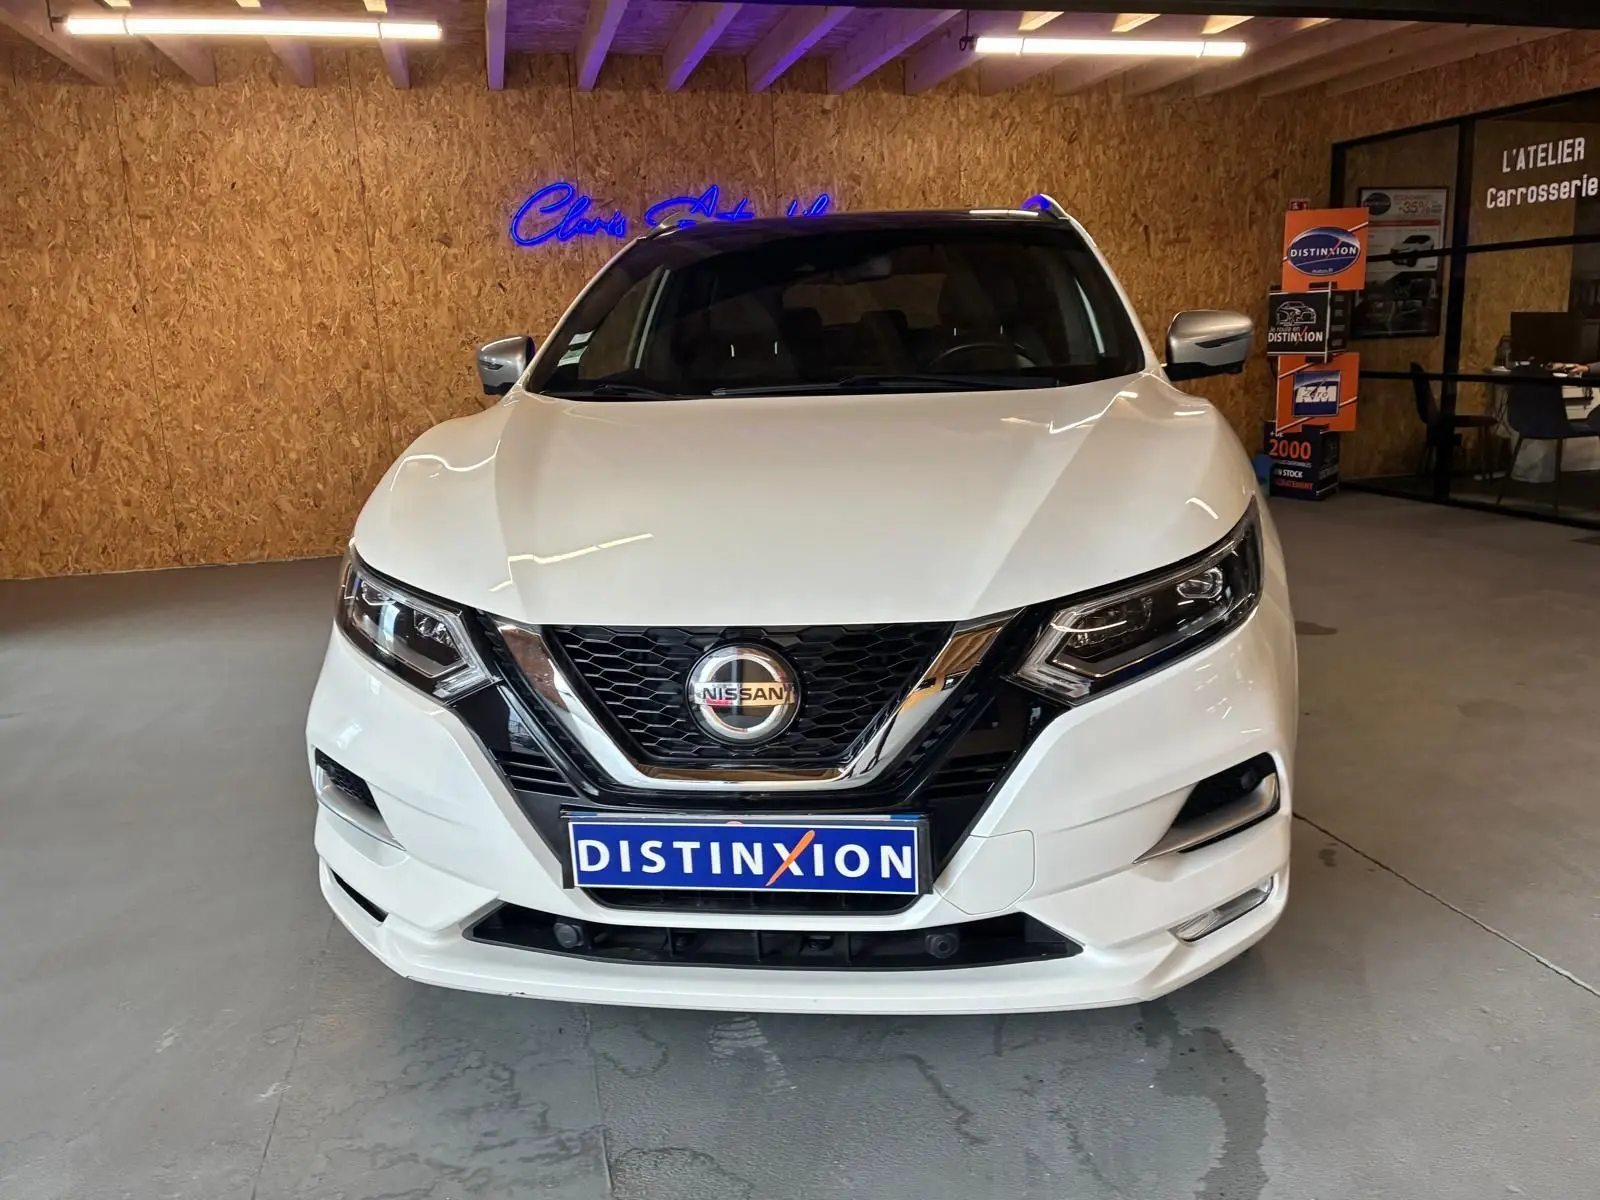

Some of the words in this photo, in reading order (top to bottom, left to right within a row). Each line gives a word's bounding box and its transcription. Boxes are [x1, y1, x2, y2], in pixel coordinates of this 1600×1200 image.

[1502, 136, 1585, 173] L'ATELIER
[1486, 173, 1599, 209] Carrosserie
[1290, 243, 1357, 258] DISTINXION
[1268, 328, 1324, 344] DISTINXION
[1268, 438, 1312, 460] 2000
[1282, 469, 1303, 478] STOCK
[702, 686, 784, 701] NISSAN
[577, 832, 912, 885] DISTINXION
